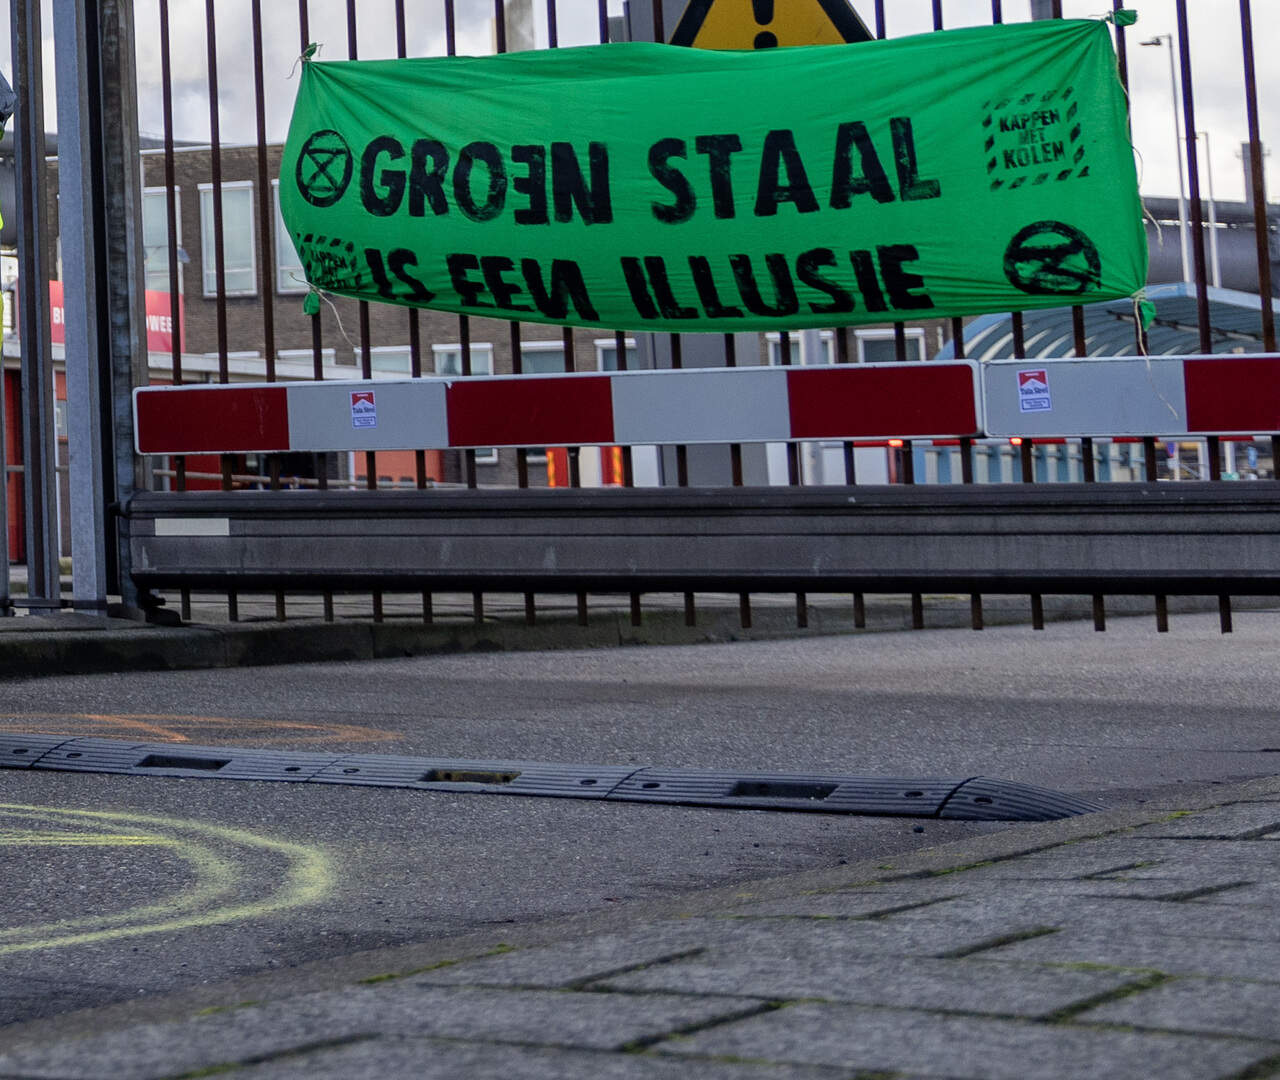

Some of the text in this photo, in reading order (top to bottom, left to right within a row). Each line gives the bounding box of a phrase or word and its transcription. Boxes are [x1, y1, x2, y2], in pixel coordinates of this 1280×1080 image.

[999, 109, 1060, 133] KAPPEN
[647, 117, 942, 225] STAAL
[1003, 140, 1065, 170] KOLEN
[364, 248, 437, 302] IS
[620, 244, 935, 320] ILLUSIE
